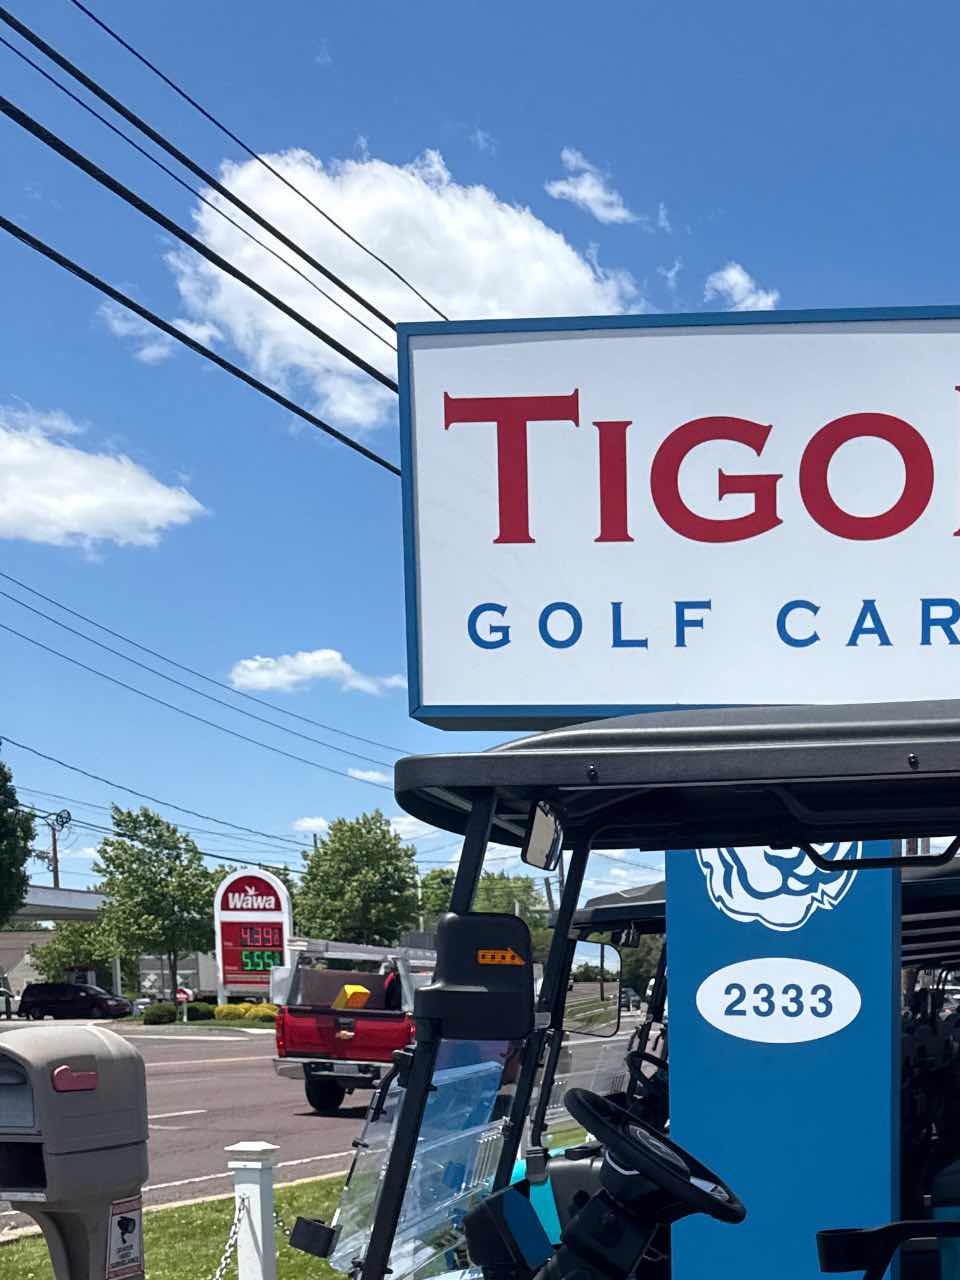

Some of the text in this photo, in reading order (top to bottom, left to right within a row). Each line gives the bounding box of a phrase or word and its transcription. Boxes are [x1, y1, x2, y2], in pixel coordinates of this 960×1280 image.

[467, 599, 712, 650] GOLF
[228, 892, 276, 909] Wawa
[723, 982, 834, 1019] 2333
